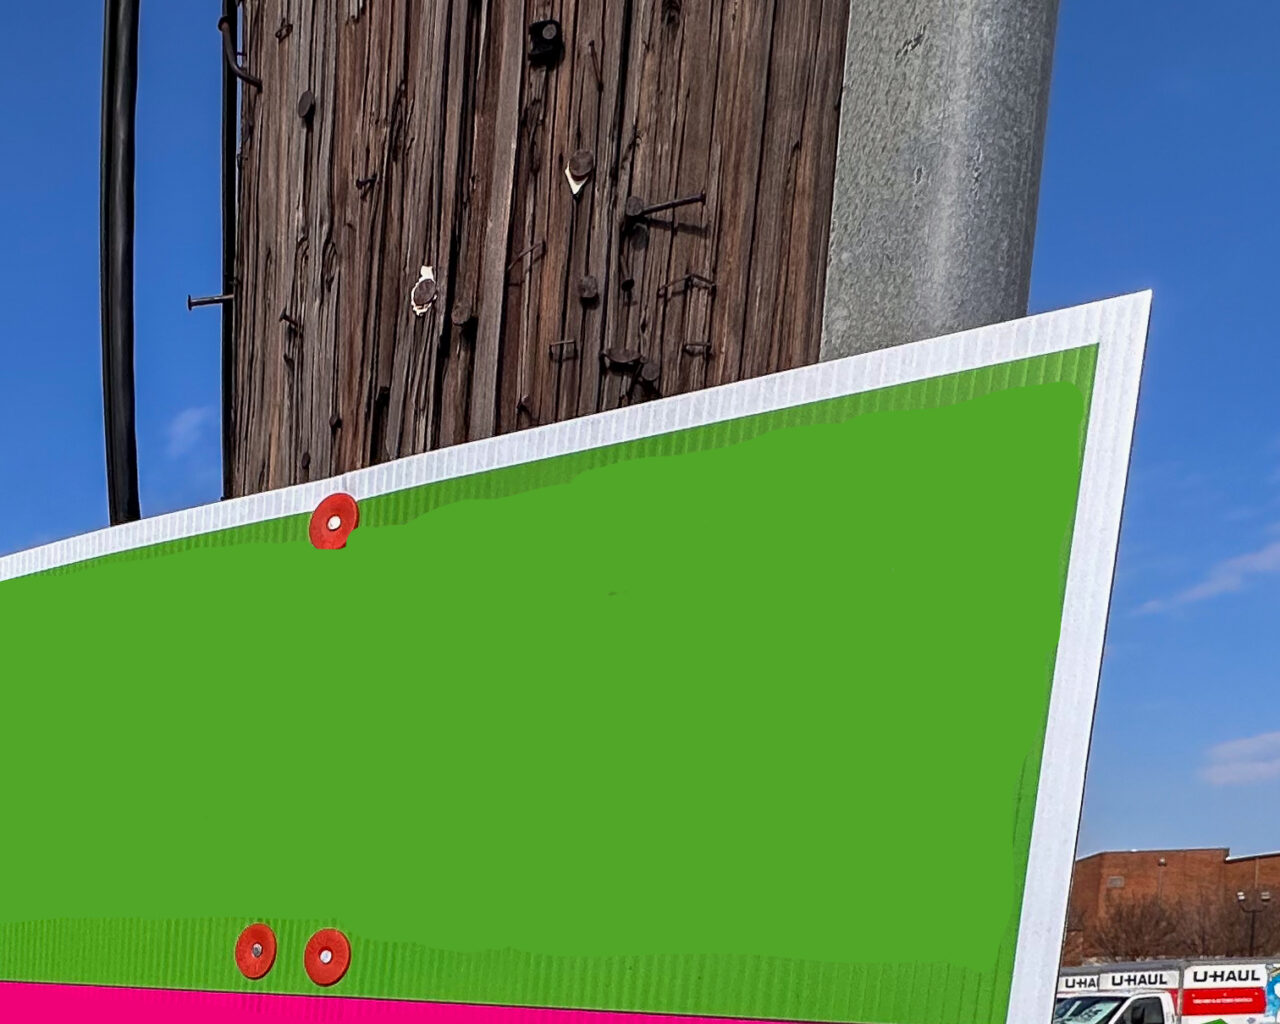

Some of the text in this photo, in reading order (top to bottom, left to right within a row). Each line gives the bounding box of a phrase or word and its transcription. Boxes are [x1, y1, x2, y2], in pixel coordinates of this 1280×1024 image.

[1111, 973, 1168, 986] U-HAUL
[1193, 969, 1261, 983] U-HAUL
[1065, 978, 1100, 989] U-HA
